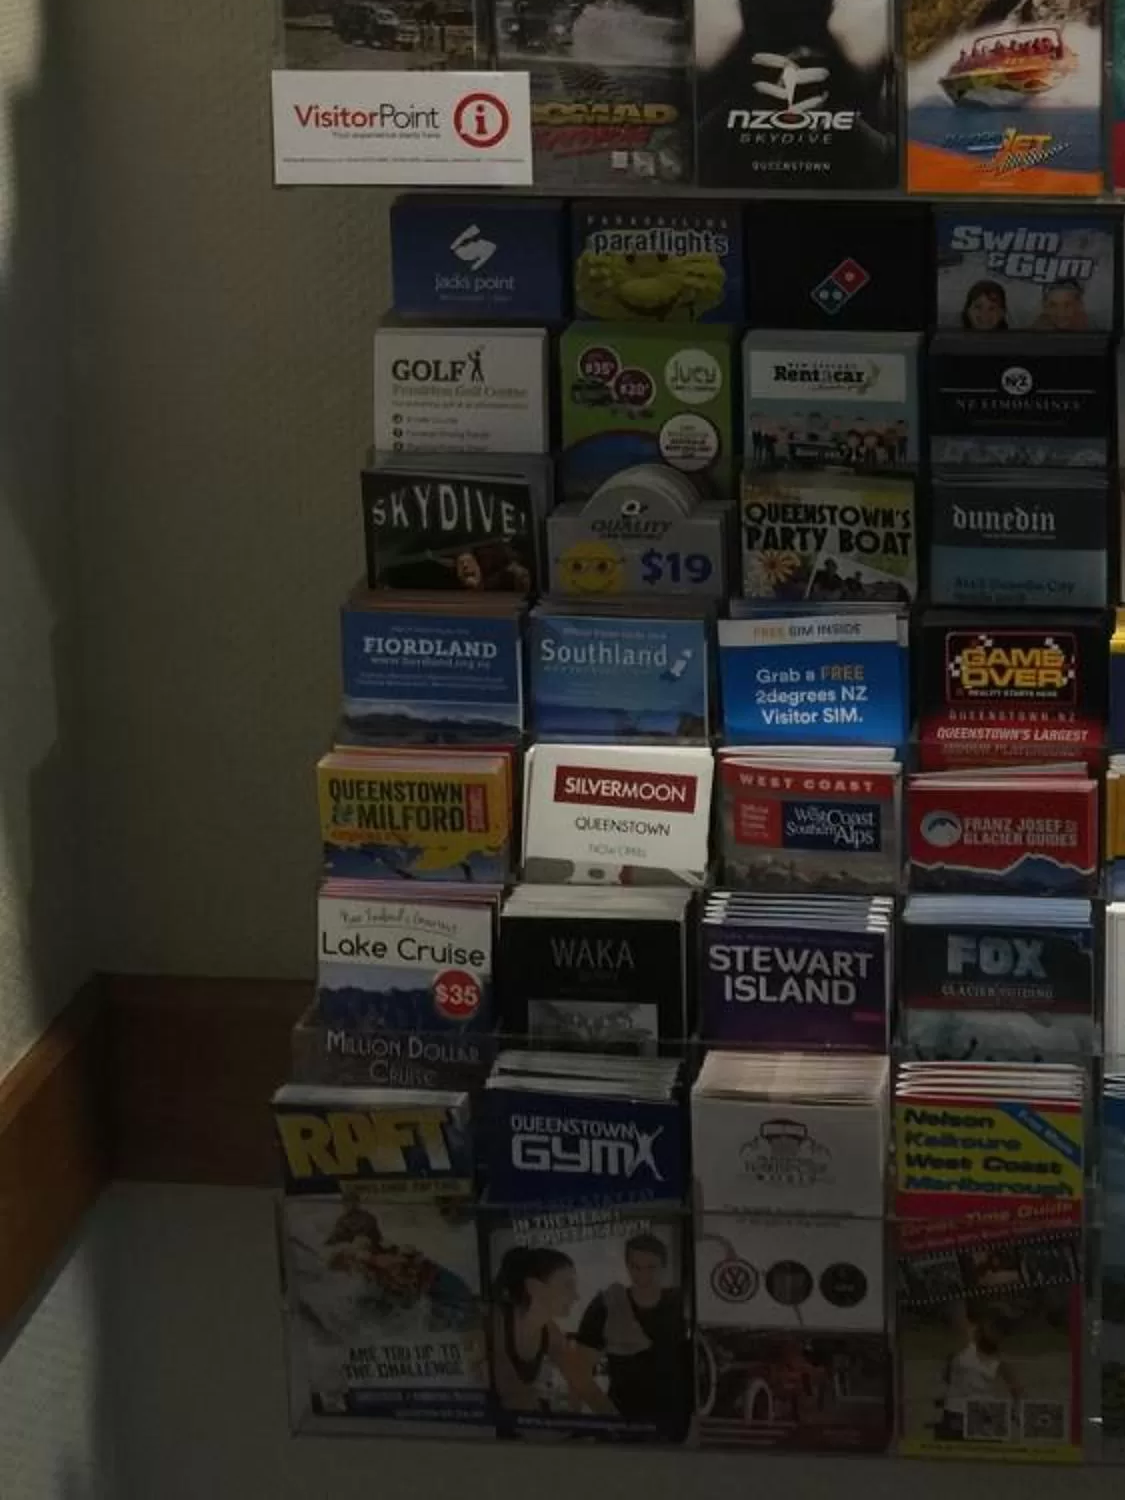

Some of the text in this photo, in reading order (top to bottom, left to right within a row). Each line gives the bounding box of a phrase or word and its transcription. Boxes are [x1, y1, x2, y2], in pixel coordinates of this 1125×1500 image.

[592, 230, 729, 257] paraflights
[392, 359, 464, 381] GOLF
[745, 503, 911, 528] QUEENSTOWN'S
[746, 526, 912, 557] PARTY BOAT
[641, 548, 713, 585] $19
[540, 639, 669, 667] Southland
[563, 776, 687, 803] SILVERMOON
[322, 933, 486, 967] Lake Cruise
[708, 944, 874, 979] STEWART
[946, 934, 1048, 978] FOX
[435, 985, 478, 1006] $35
[724, 974, 856, 1006] ISLAND
[904, 1108, 995, 1129] Nelson
[275, 1109, 451, 1179] RAFT
